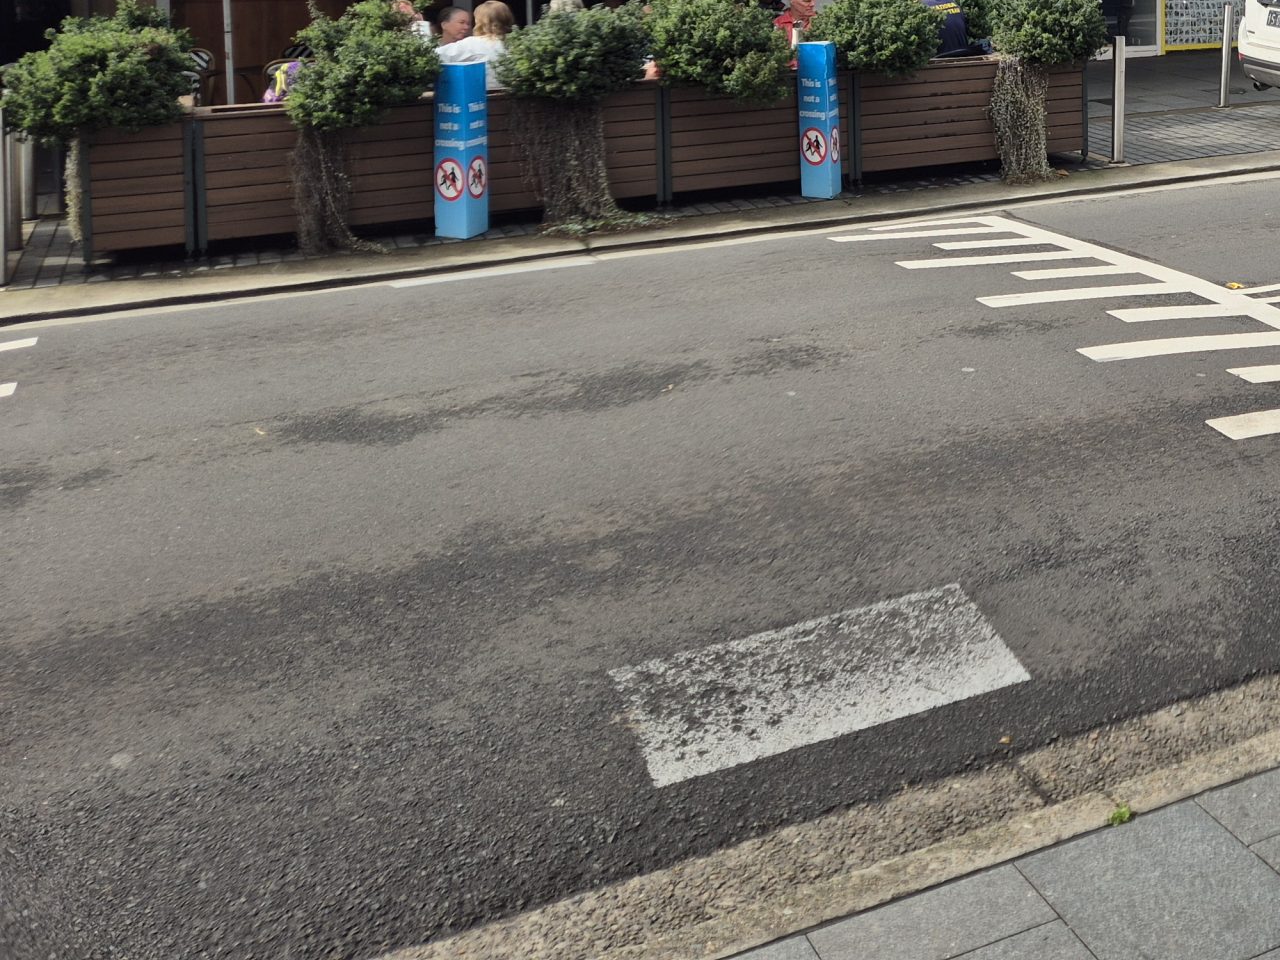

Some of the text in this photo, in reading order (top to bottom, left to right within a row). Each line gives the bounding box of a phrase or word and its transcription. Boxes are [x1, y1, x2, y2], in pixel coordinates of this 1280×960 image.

[801, 78, 822, 88] This is
[803, 94, 815, 104] not
[437, 102, 452, 114] This
[799, 109, 826, 121] crossing
[439, 120, 453, 131] not
[435, 138, 465, 151] crossing
